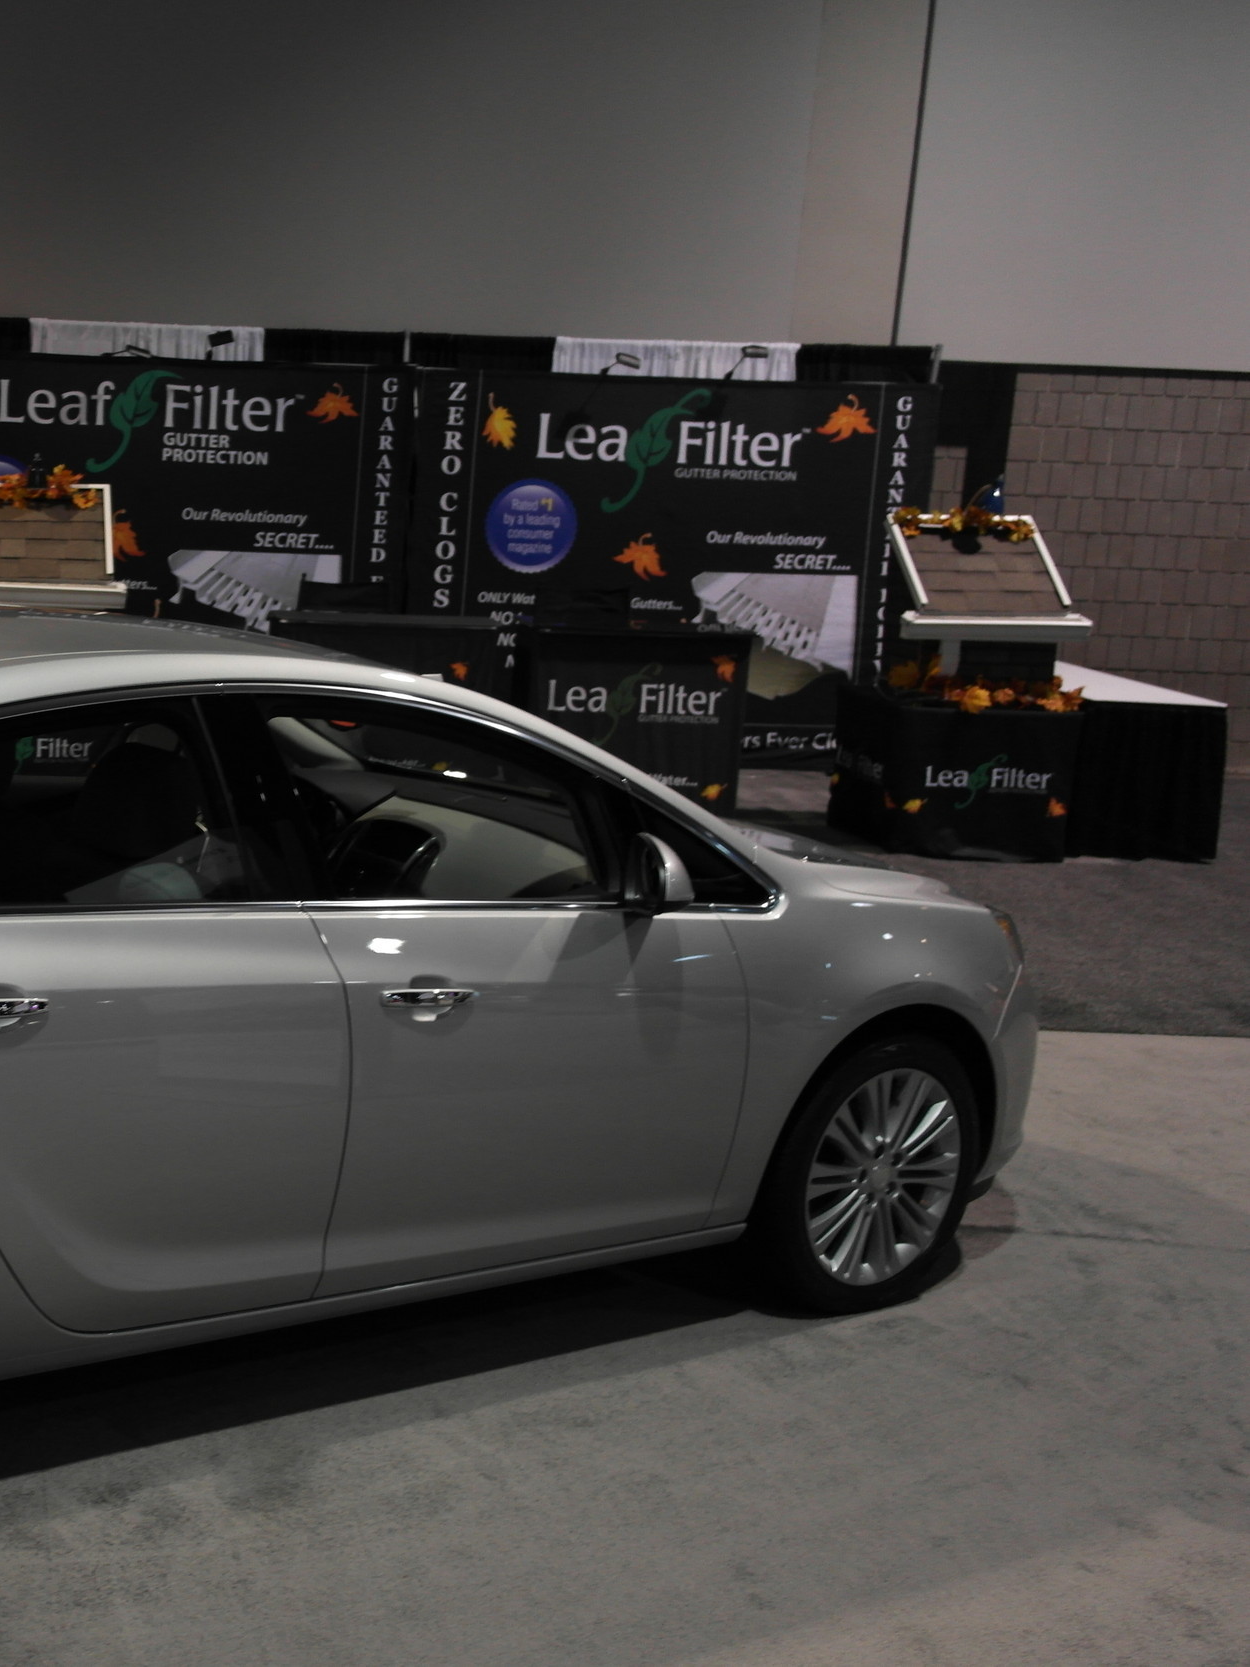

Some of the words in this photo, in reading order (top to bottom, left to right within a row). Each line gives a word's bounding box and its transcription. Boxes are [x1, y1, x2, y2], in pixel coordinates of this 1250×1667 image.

[164, 384, 296, 433] Filter
[440, 381, 468, 475] ZERO
[162, 431, 231, 449] GUTTER
[676, 421, 803, 468] Filter
[161, 448, 269, 466] PROTECTION
[369, 377, 399, 563] GUARANTEED
[674, 467, 721, 480] GUTTER
[722, 468, 798, 482] PROTECTION
[181, 507, 209, 521] Our
[209, 508, 308, 528] Revolutionary
[432, 492, 458, 609] CLOGS
[706, 530, 732, 544] Our
[732, 531, 827, 549] Revolutionary
[476, 591, 510, 604] ONLY
[511, 592, 536, 605] Wat
[639, 683, 722, 716] Filter
[35, 737, 94, 759] Filter
[990, 767, 1053, 790] Filter
